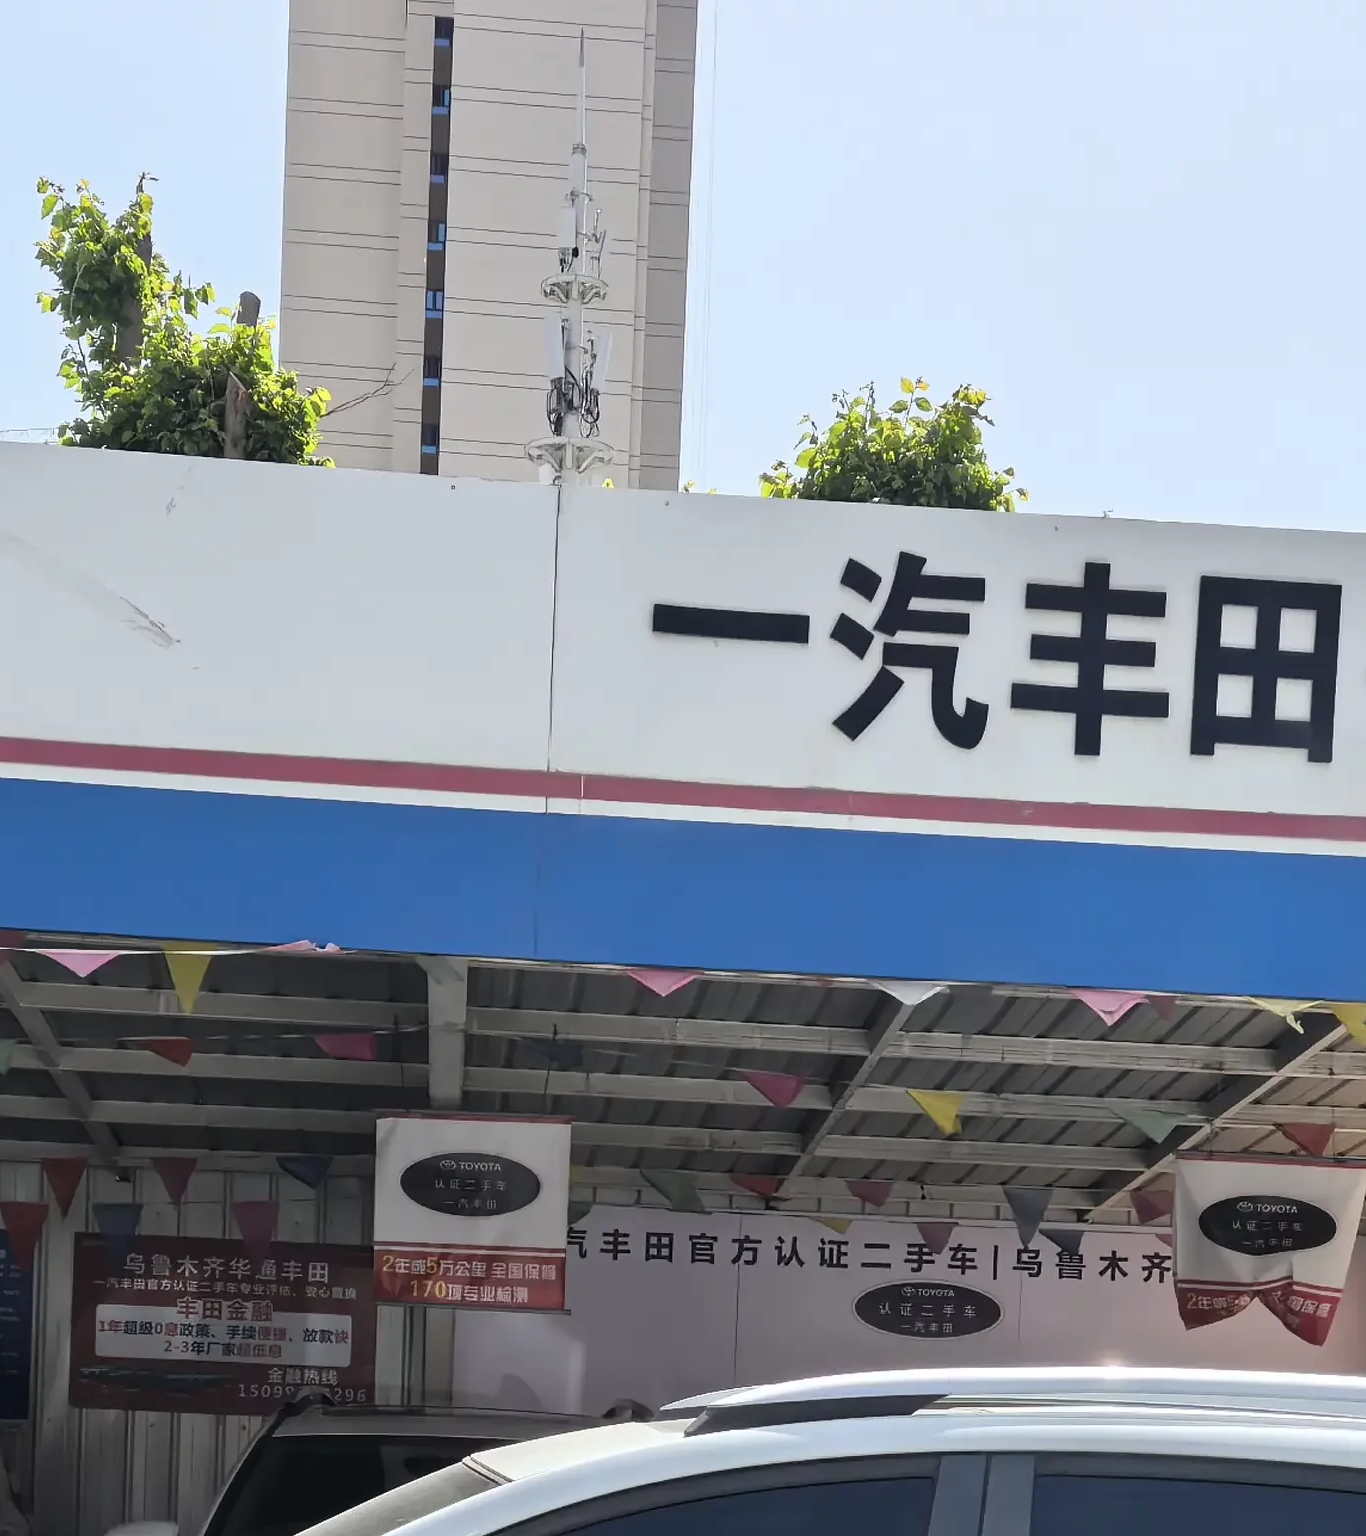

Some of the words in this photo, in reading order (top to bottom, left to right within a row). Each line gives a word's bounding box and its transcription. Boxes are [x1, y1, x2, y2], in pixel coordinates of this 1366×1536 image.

[458, 1160, 503, 1172] TOYOTA
[1256, 1203, 1299, 1214] TOYOTA
[123, 1252, 330, 1284] 乌鲁木齐华通丰田
[490, 1262, 557, 1281] 全国保修
[409, 1279, 529, 1304] 170项专业检测
[916, 1287, 956, 1298] TOYOTA
[175, 1295, 274, 1322] 丰田金融
[878, 1301, 977, 1319] 认证二手车
[266, 1367, 339, 1386] 金融热线
[237, 1384, 368, 1403] 15099296
